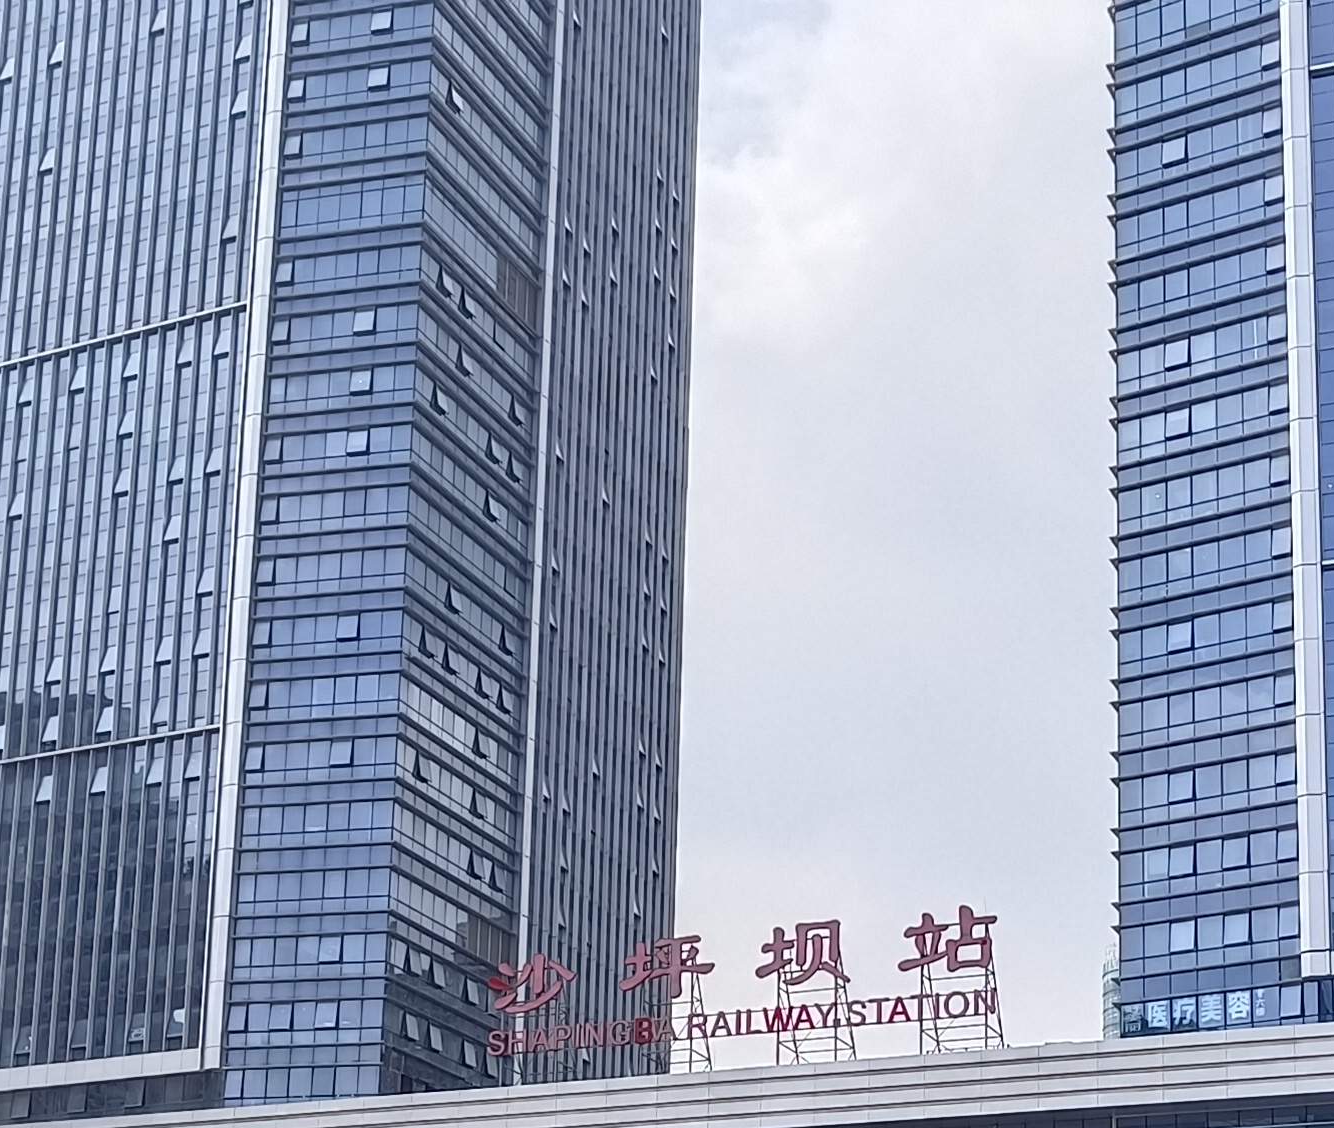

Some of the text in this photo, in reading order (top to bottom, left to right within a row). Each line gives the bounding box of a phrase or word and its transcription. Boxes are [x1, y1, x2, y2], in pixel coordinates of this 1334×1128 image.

[486, 904, 999, 1014] 沙坪坝站
[487, 989, 997, 1057] SHAPINGBA RAILWAY STATION
